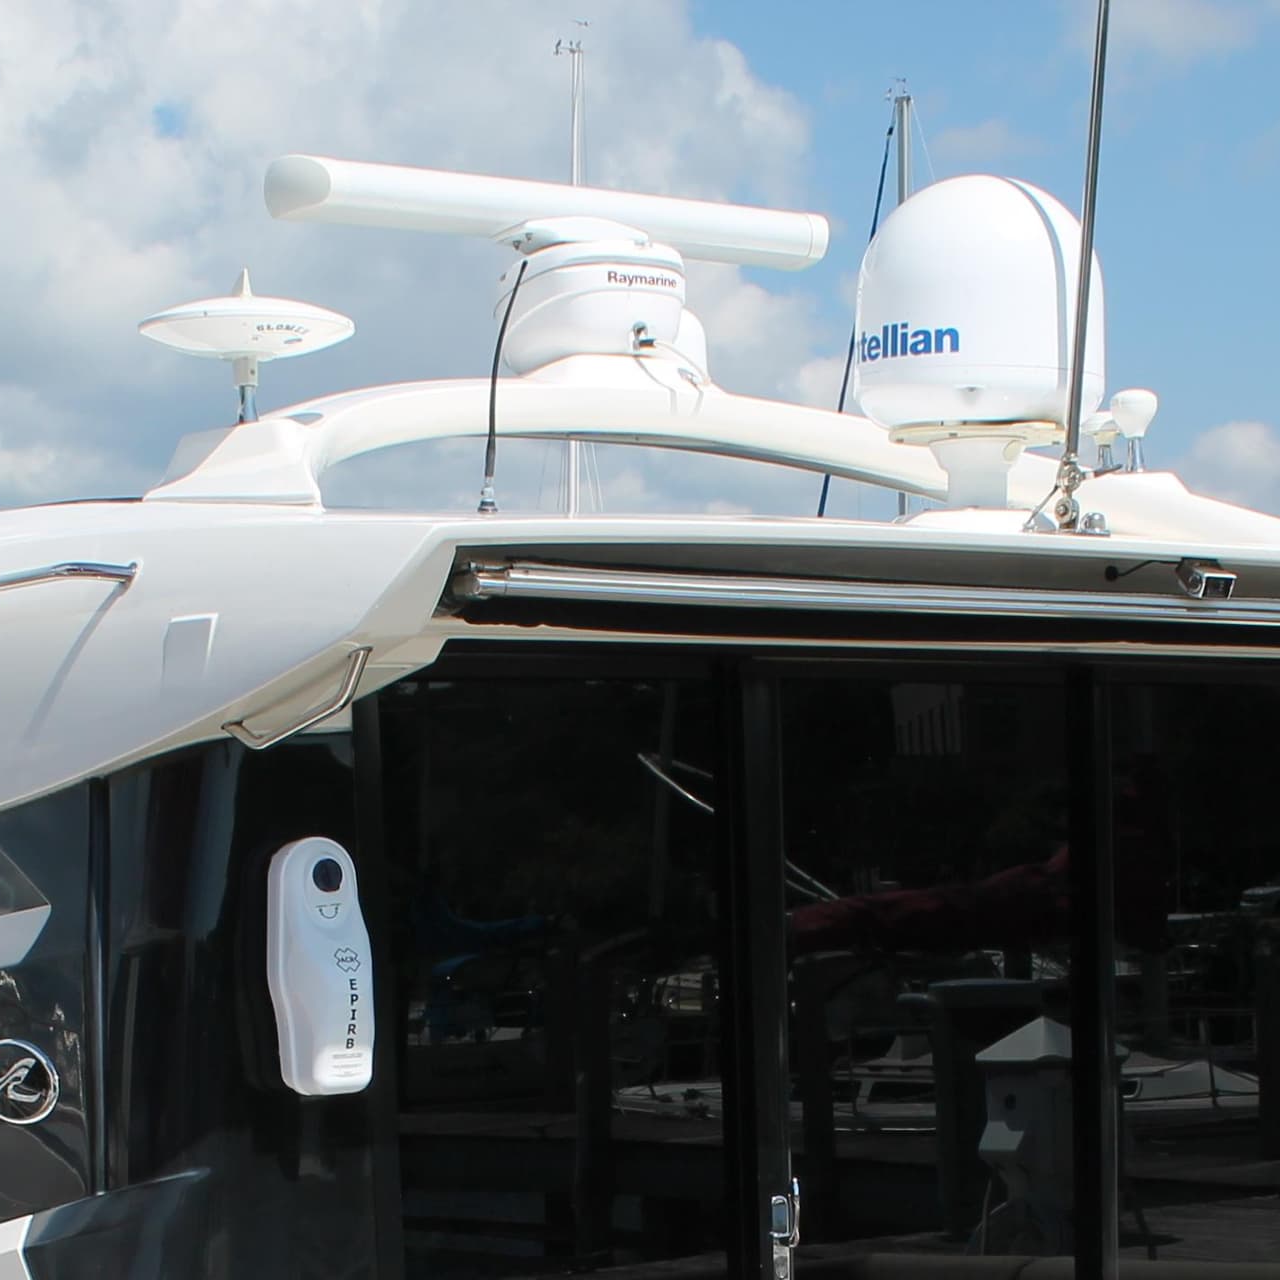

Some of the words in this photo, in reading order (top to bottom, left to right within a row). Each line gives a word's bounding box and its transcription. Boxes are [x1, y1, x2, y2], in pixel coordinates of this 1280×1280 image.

[607, 270, 677, 288] Raymarine
[859, 322, 960, 363] tellian
[345, 978, 359, 1050] EPIRB
